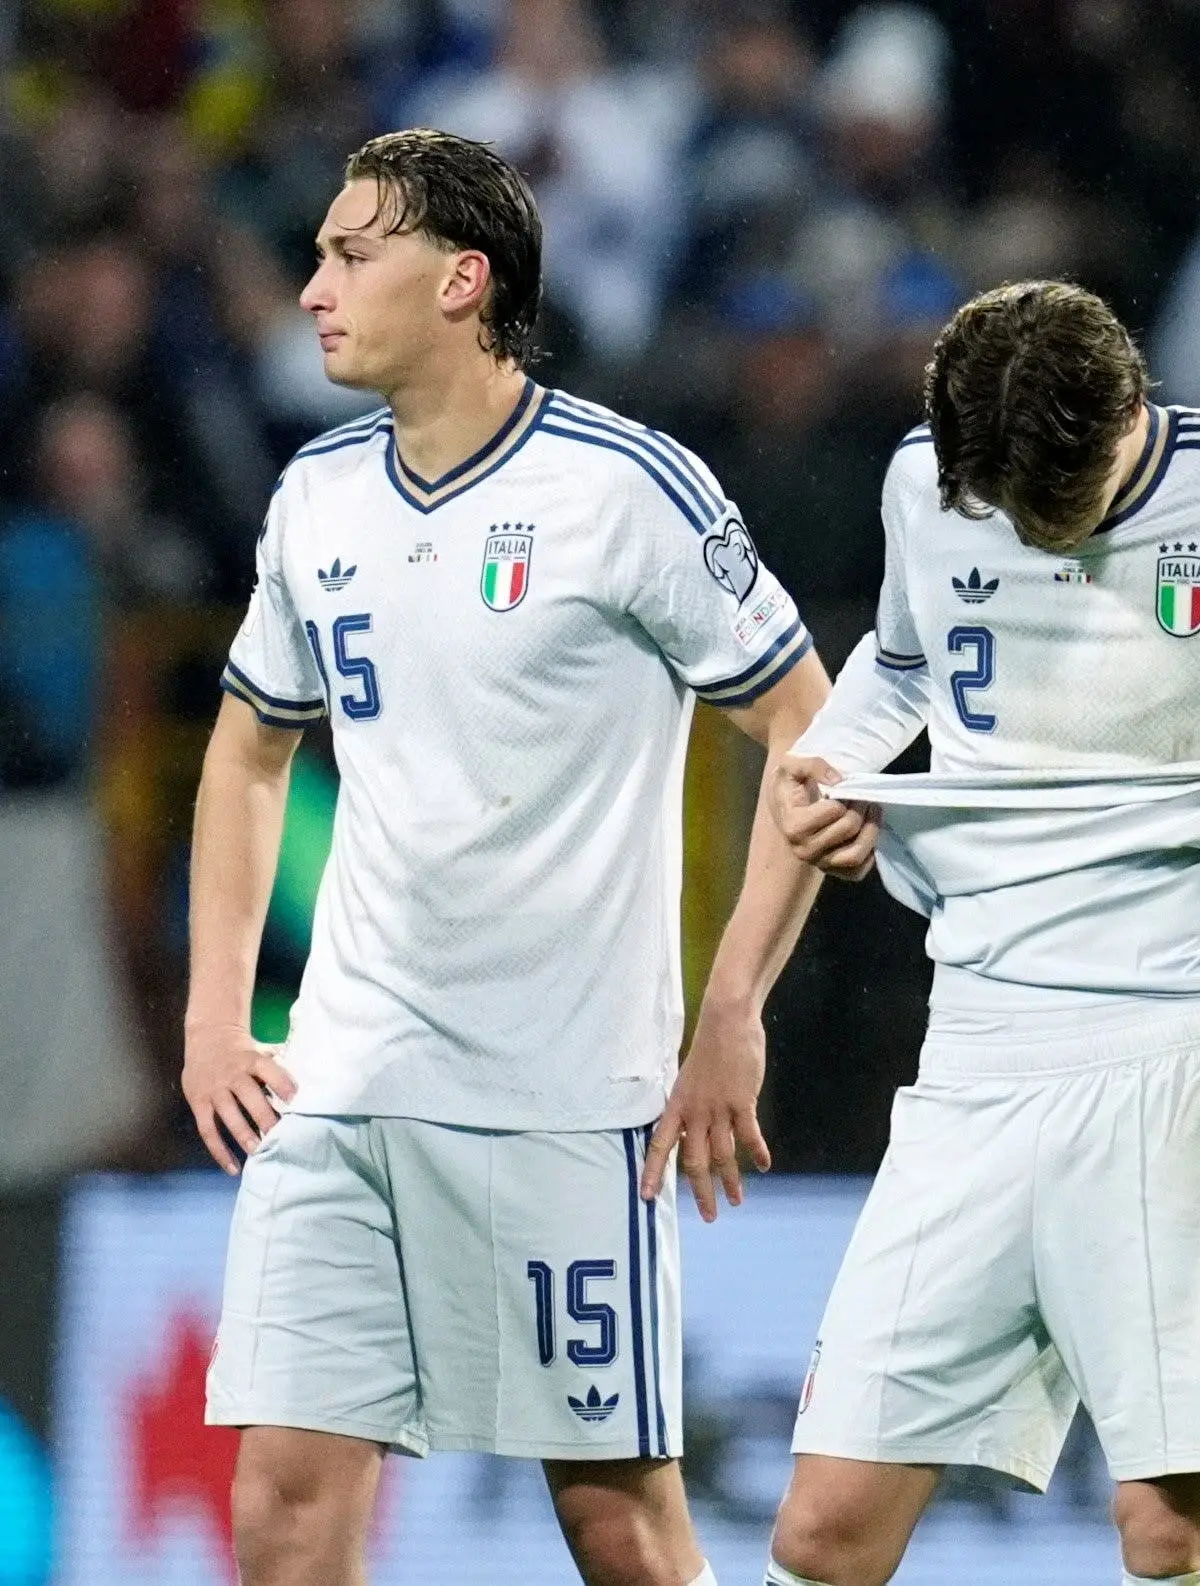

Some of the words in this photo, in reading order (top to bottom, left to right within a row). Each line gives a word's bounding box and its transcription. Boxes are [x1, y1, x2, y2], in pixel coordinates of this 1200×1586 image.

[489, 540, 526, 554] ITALIA
[306, 613, 383, 722] 15
[947, 626, 998, 734] 2
[527, 1260, 619, 1368] 15
